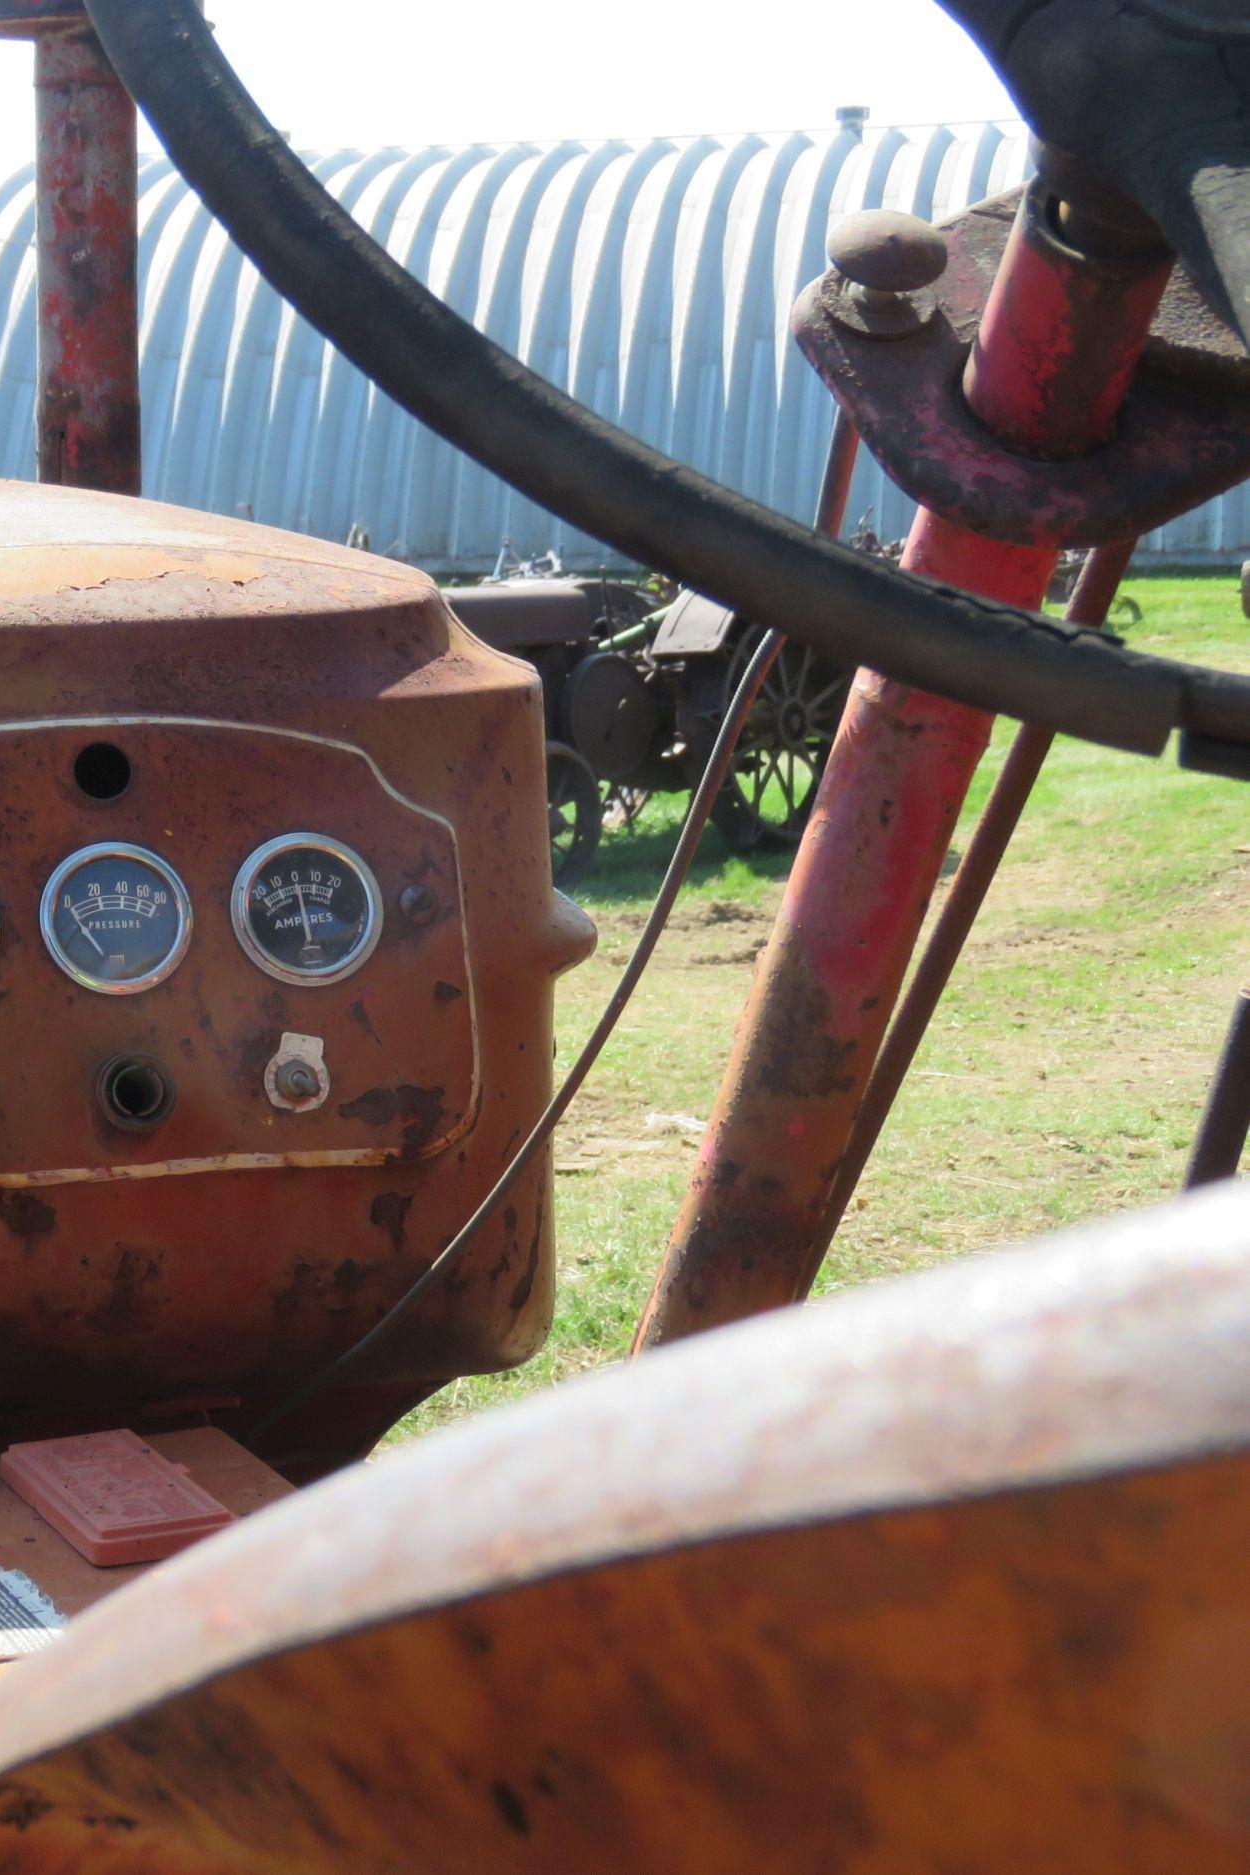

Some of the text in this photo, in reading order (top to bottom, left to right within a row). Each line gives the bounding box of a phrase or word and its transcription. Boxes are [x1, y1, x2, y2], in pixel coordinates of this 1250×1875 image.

[252, 870, 341, 900] 20 10 0 10 20
[63, 881, 167, 908] 0 20 40 60 80
[308, 895, 331, 905] CHARGE
[88, 919, 142, 930] PRESSURE
[274, 912, 334, 930] AMPERES
